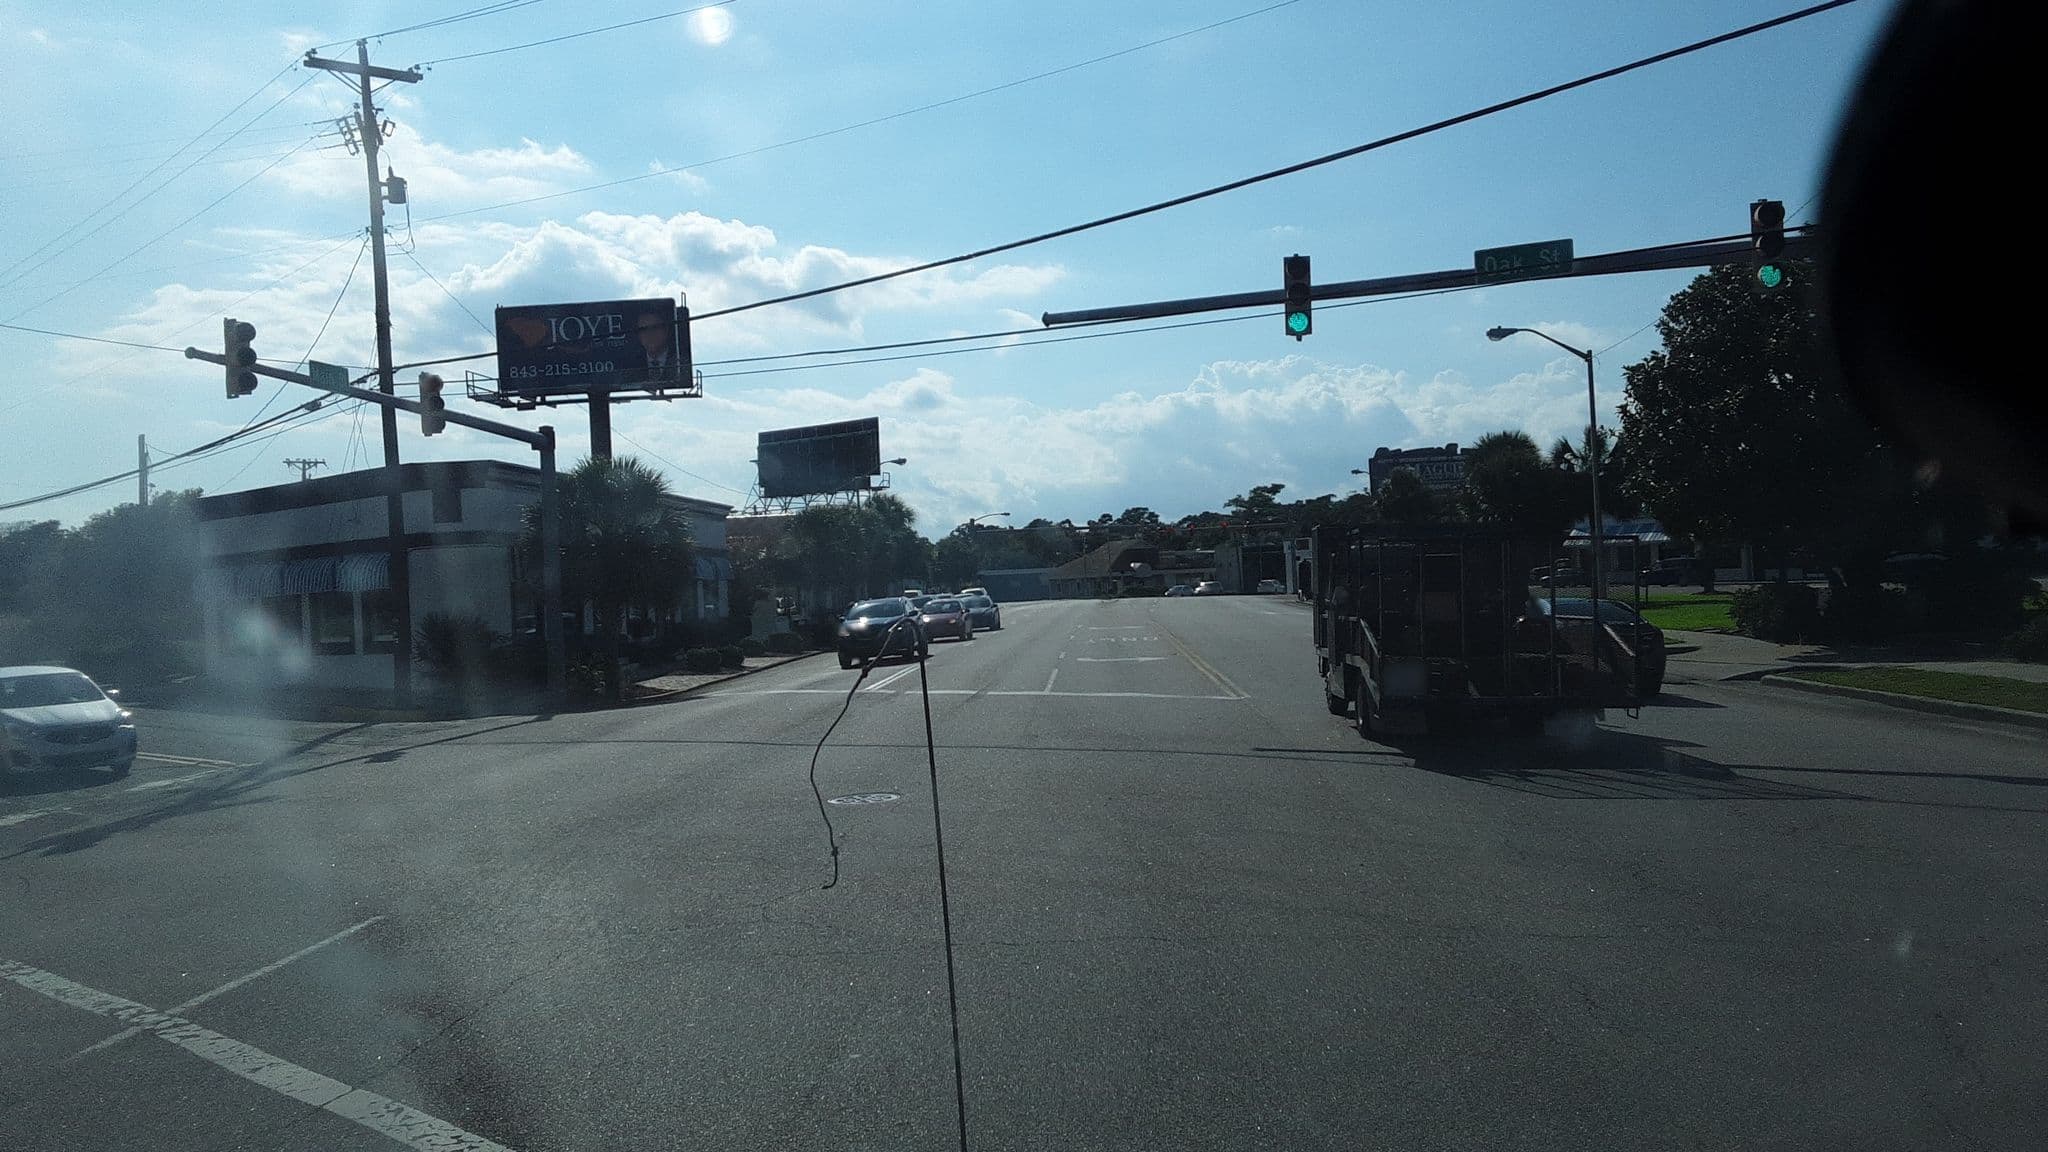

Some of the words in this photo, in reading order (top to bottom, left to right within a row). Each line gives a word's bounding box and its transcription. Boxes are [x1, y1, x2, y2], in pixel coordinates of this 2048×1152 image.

[1484, 255, 1524, 273] Oak
[547, 314, 625, 348] JOYE
[509, 361, 614, 379] 843-215-3100
